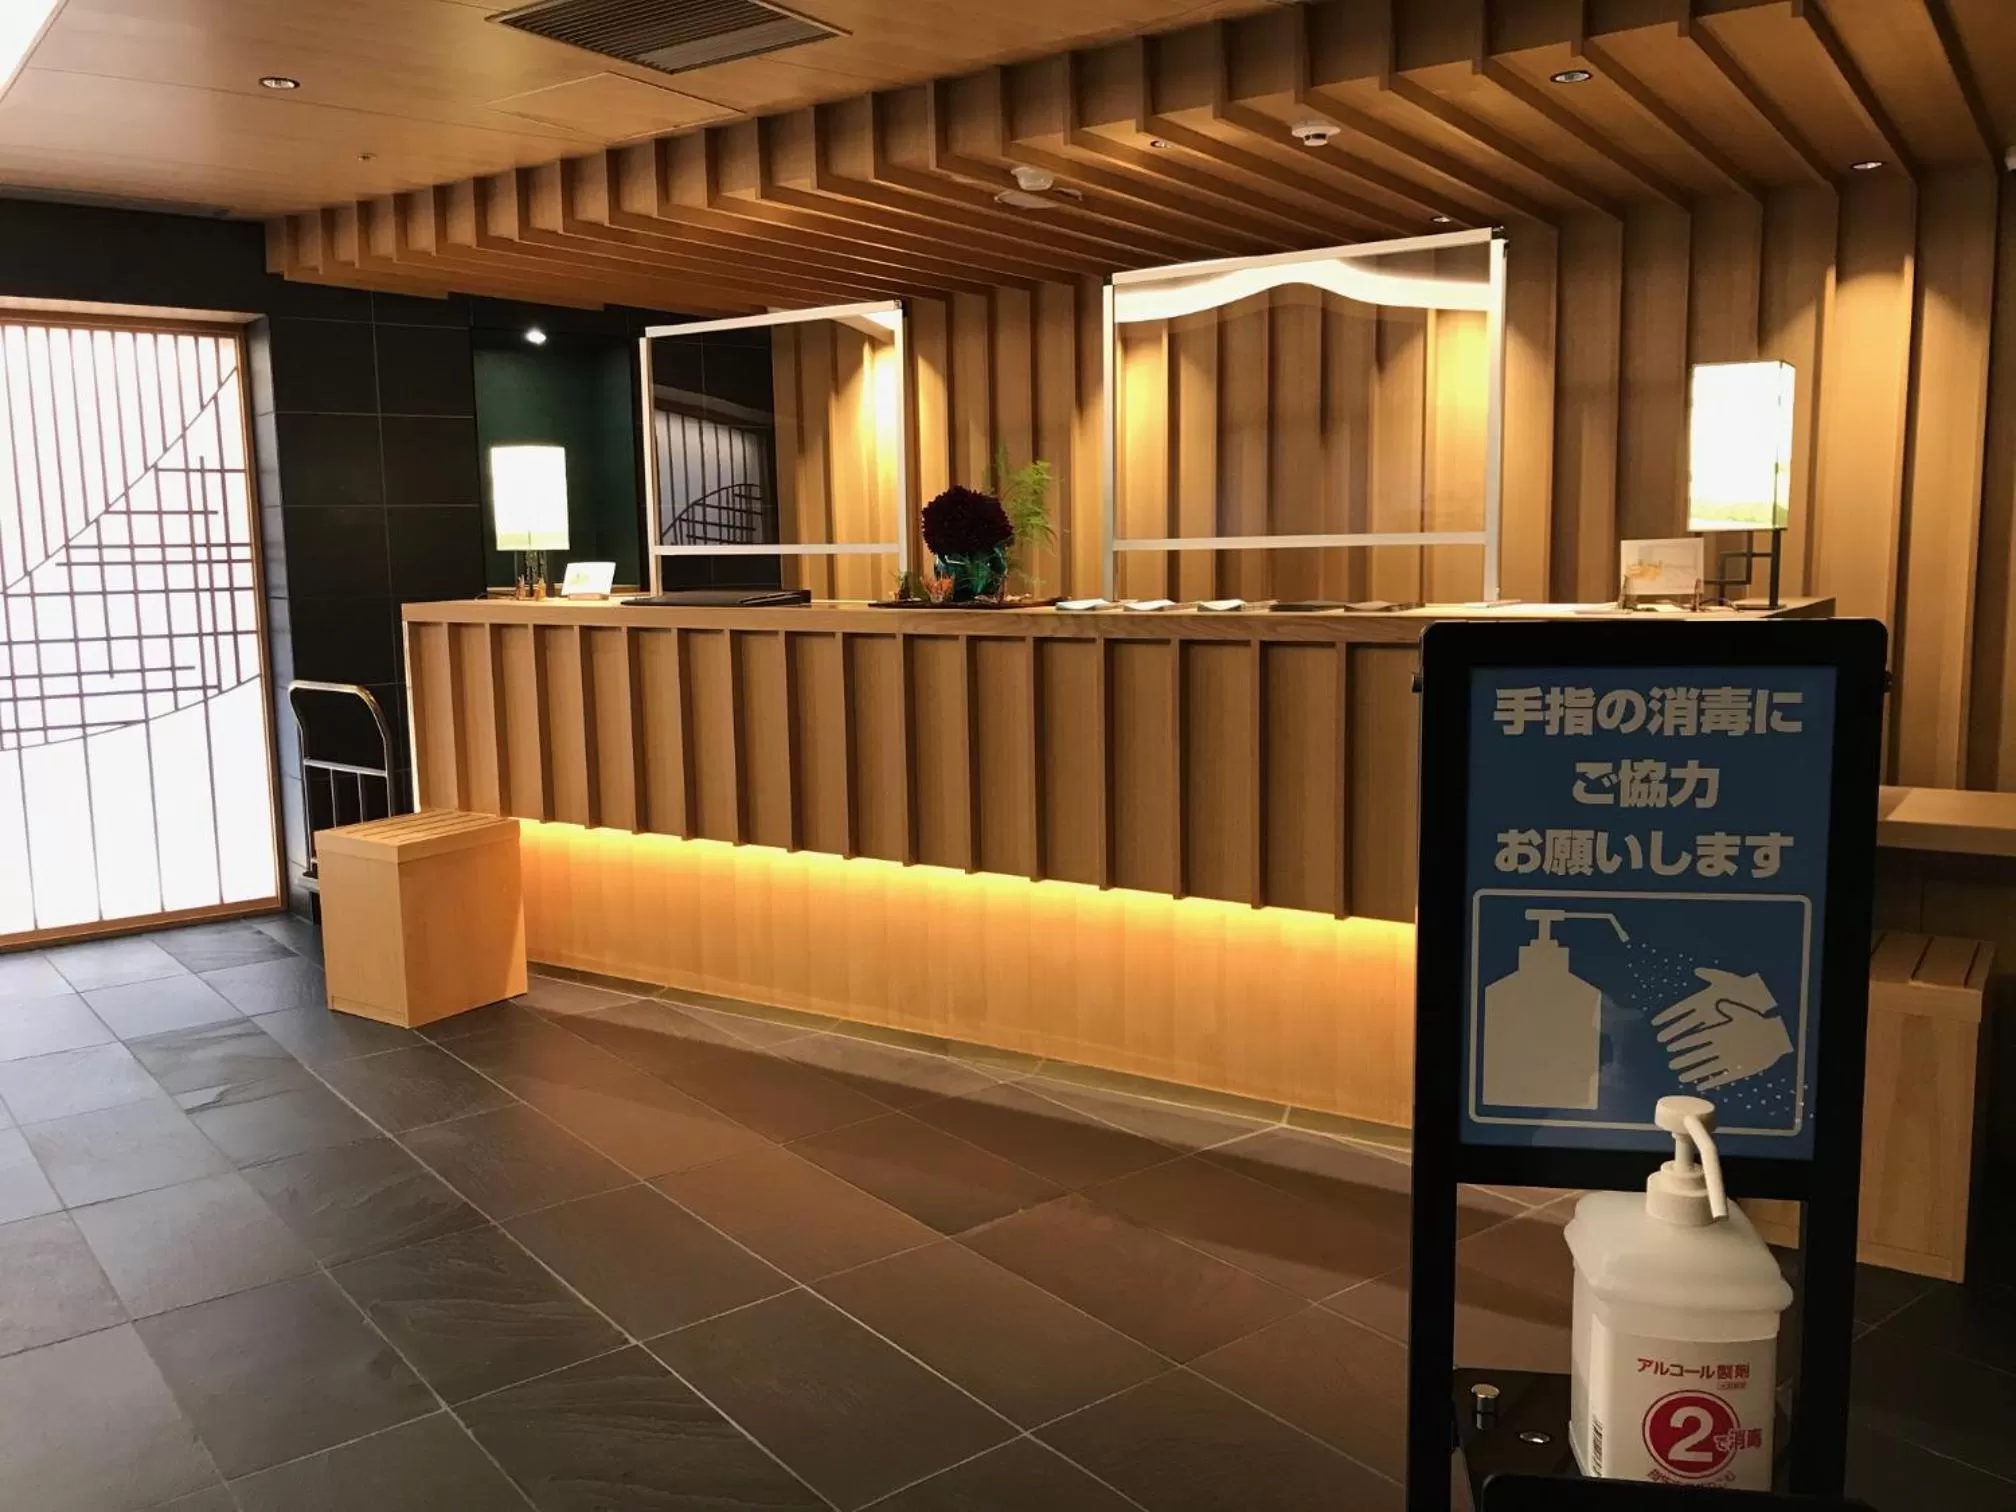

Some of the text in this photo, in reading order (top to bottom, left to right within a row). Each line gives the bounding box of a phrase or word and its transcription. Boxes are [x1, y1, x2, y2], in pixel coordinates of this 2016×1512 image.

[1493, 686, 1804, 736] 手指の消毒に
[1572, 759, 1720, 809] ご協力
[1494, 829, 1795, 879] お願いします
